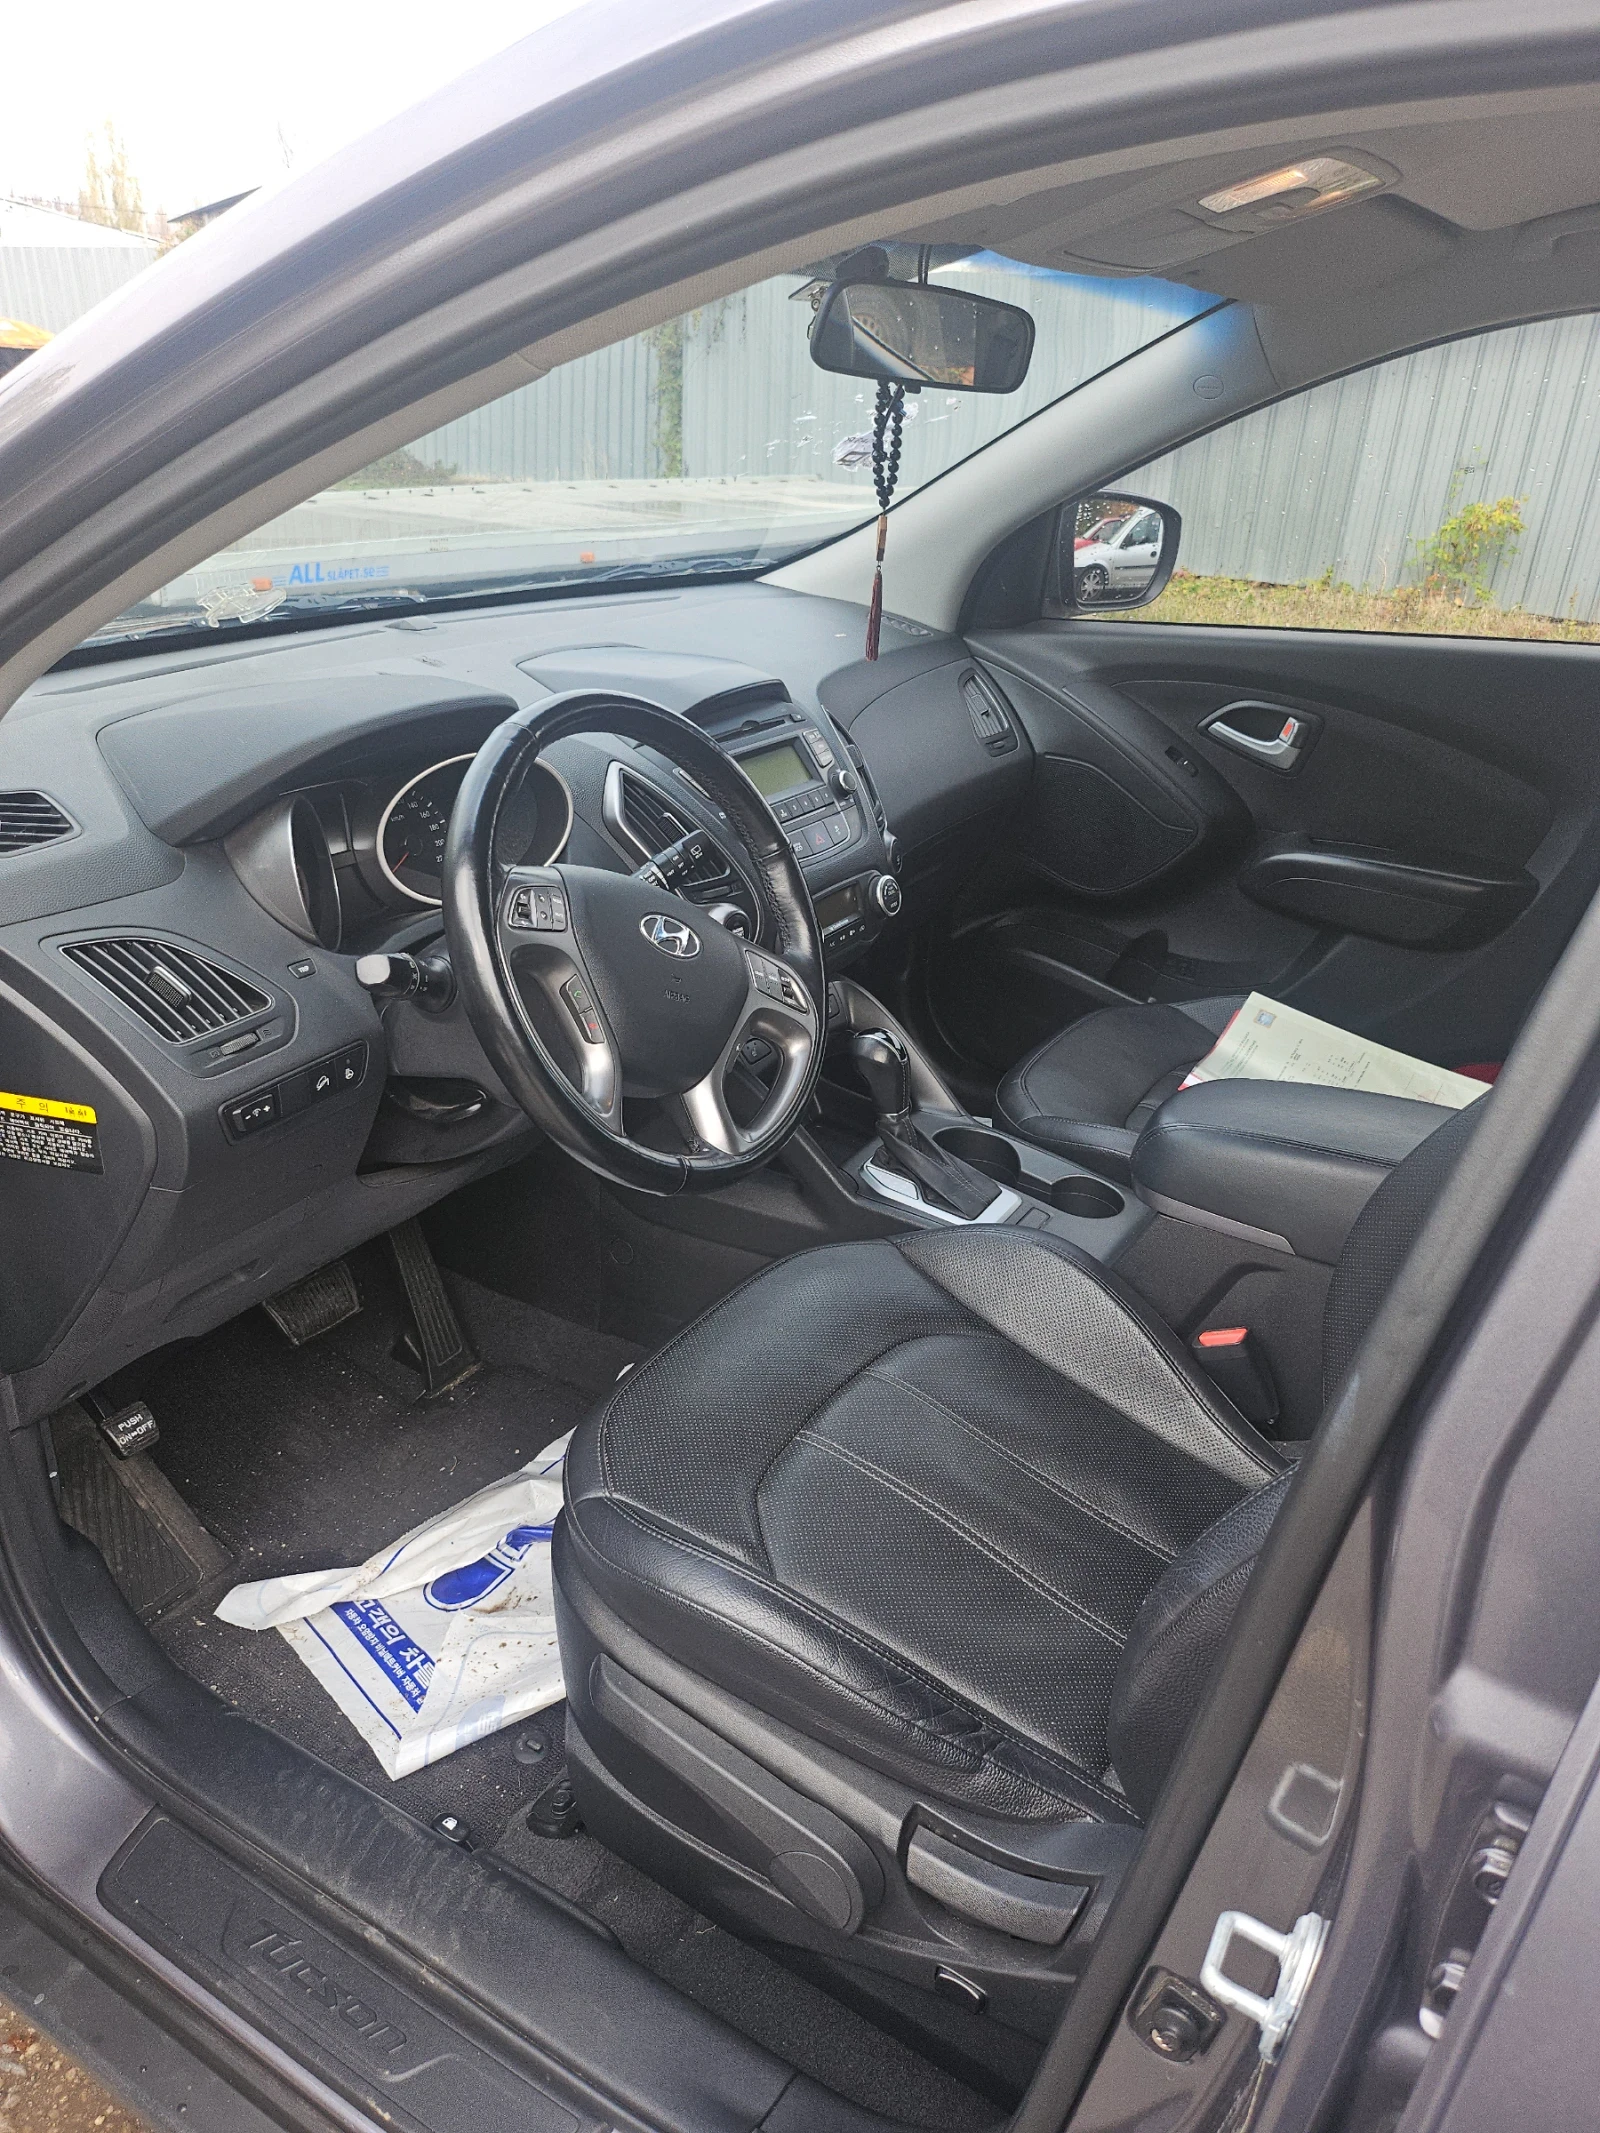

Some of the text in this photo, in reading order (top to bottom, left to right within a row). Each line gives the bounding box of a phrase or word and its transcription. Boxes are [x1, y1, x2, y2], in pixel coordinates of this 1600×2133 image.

[288, 562, 325, 585] ALL
[117, 1413, 144, 1432] PUSH
[401, 1675, 421, 1698] 자동차
